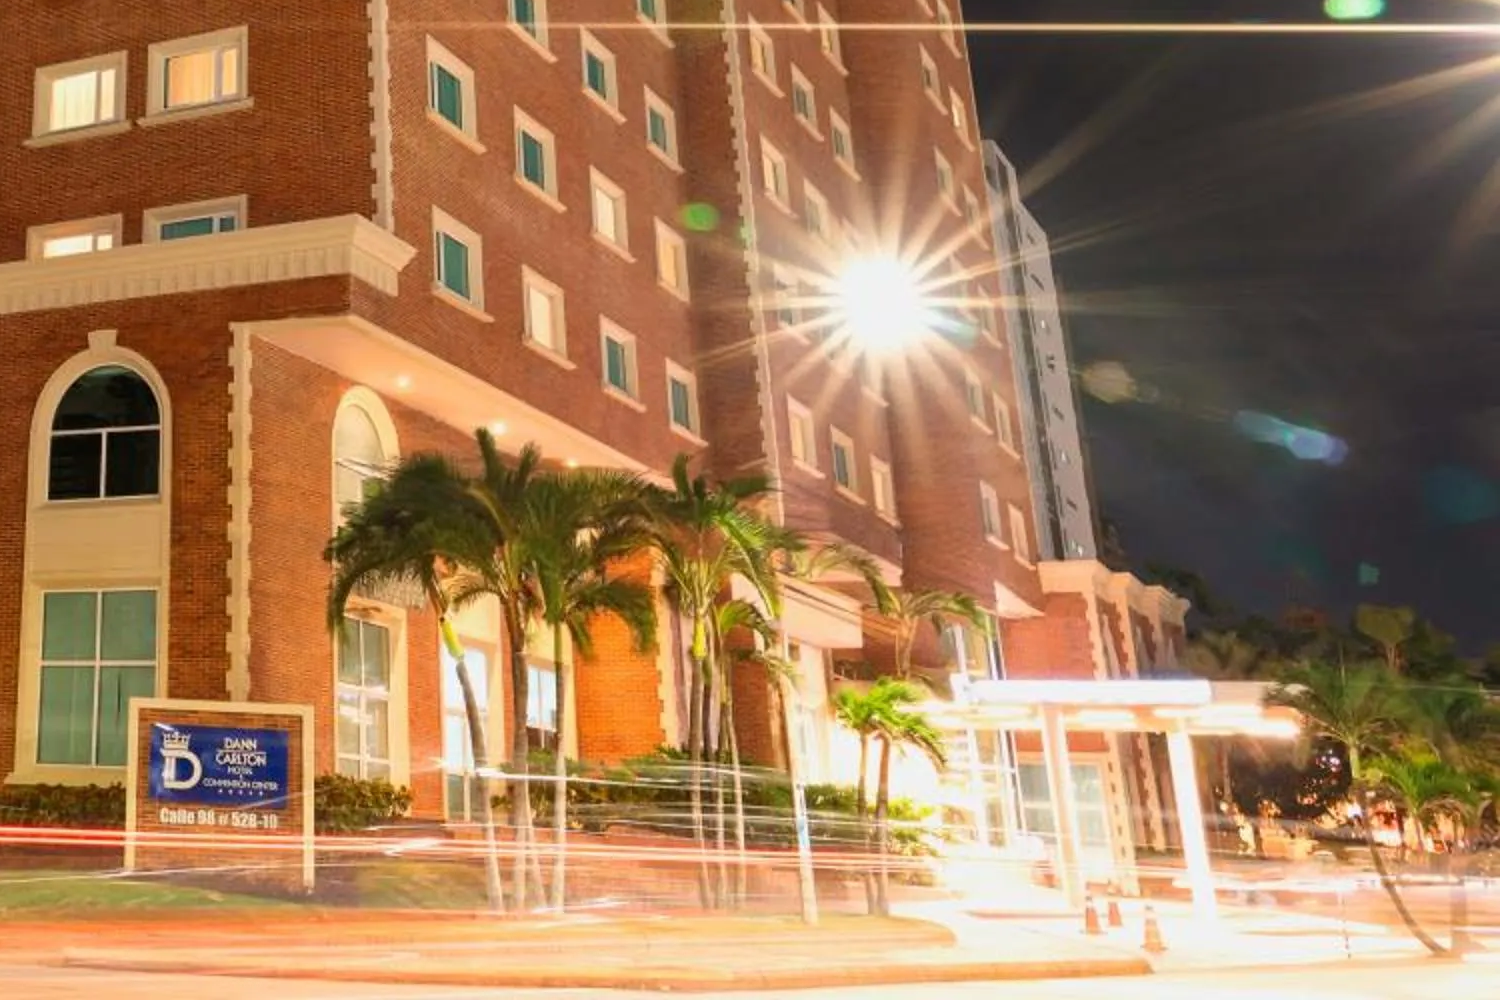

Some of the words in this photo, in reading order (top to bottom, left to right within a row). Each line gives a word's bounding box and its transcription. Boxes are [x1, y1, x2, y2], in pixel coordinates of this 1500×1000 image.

[224, 737, 258, 750] DANN
[215, 752, 268, 767] CARLTON
[160, 807, 195, 825] Calle
[198, 809, 215, 825] 98
